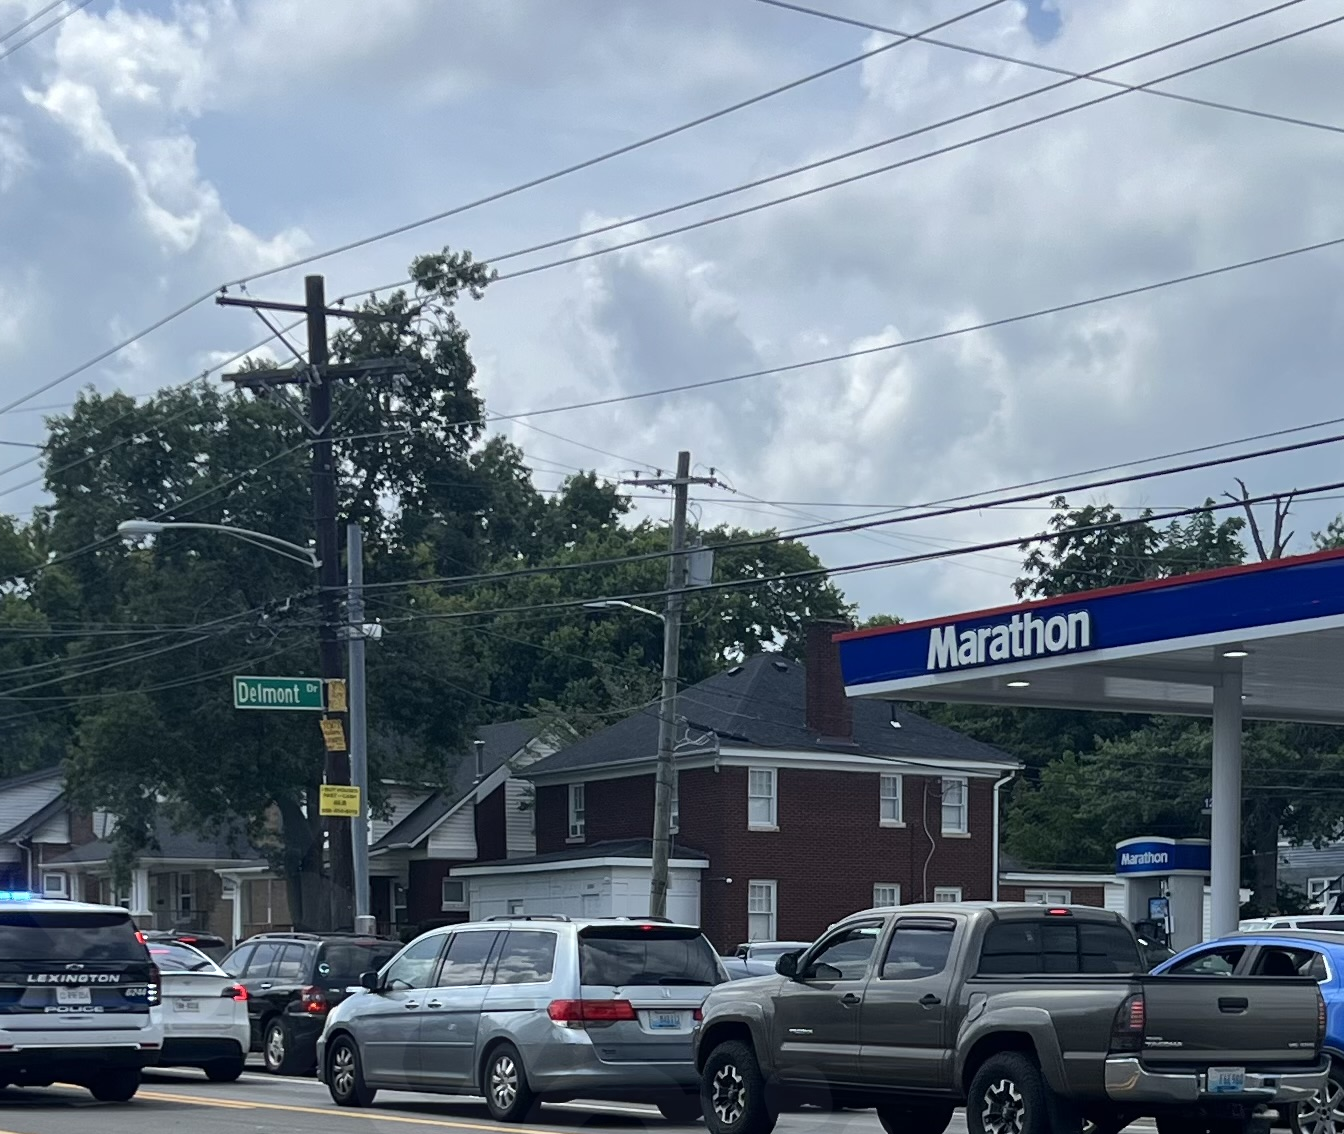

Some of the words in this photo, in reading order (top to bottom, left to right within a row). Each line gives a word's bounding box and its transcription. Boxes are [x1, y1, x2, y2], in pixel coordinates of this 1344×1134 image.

[927, 611, 1090, 670] Marathon
[238, 681, 300, 704] Delmont
[306, 684, 318, 694] Dr
[1121, 851, 1168, 866] Marathon
[27, 974, 120, 983] LEXINGTON
[44, 1005, 105, 1013] POLICE
